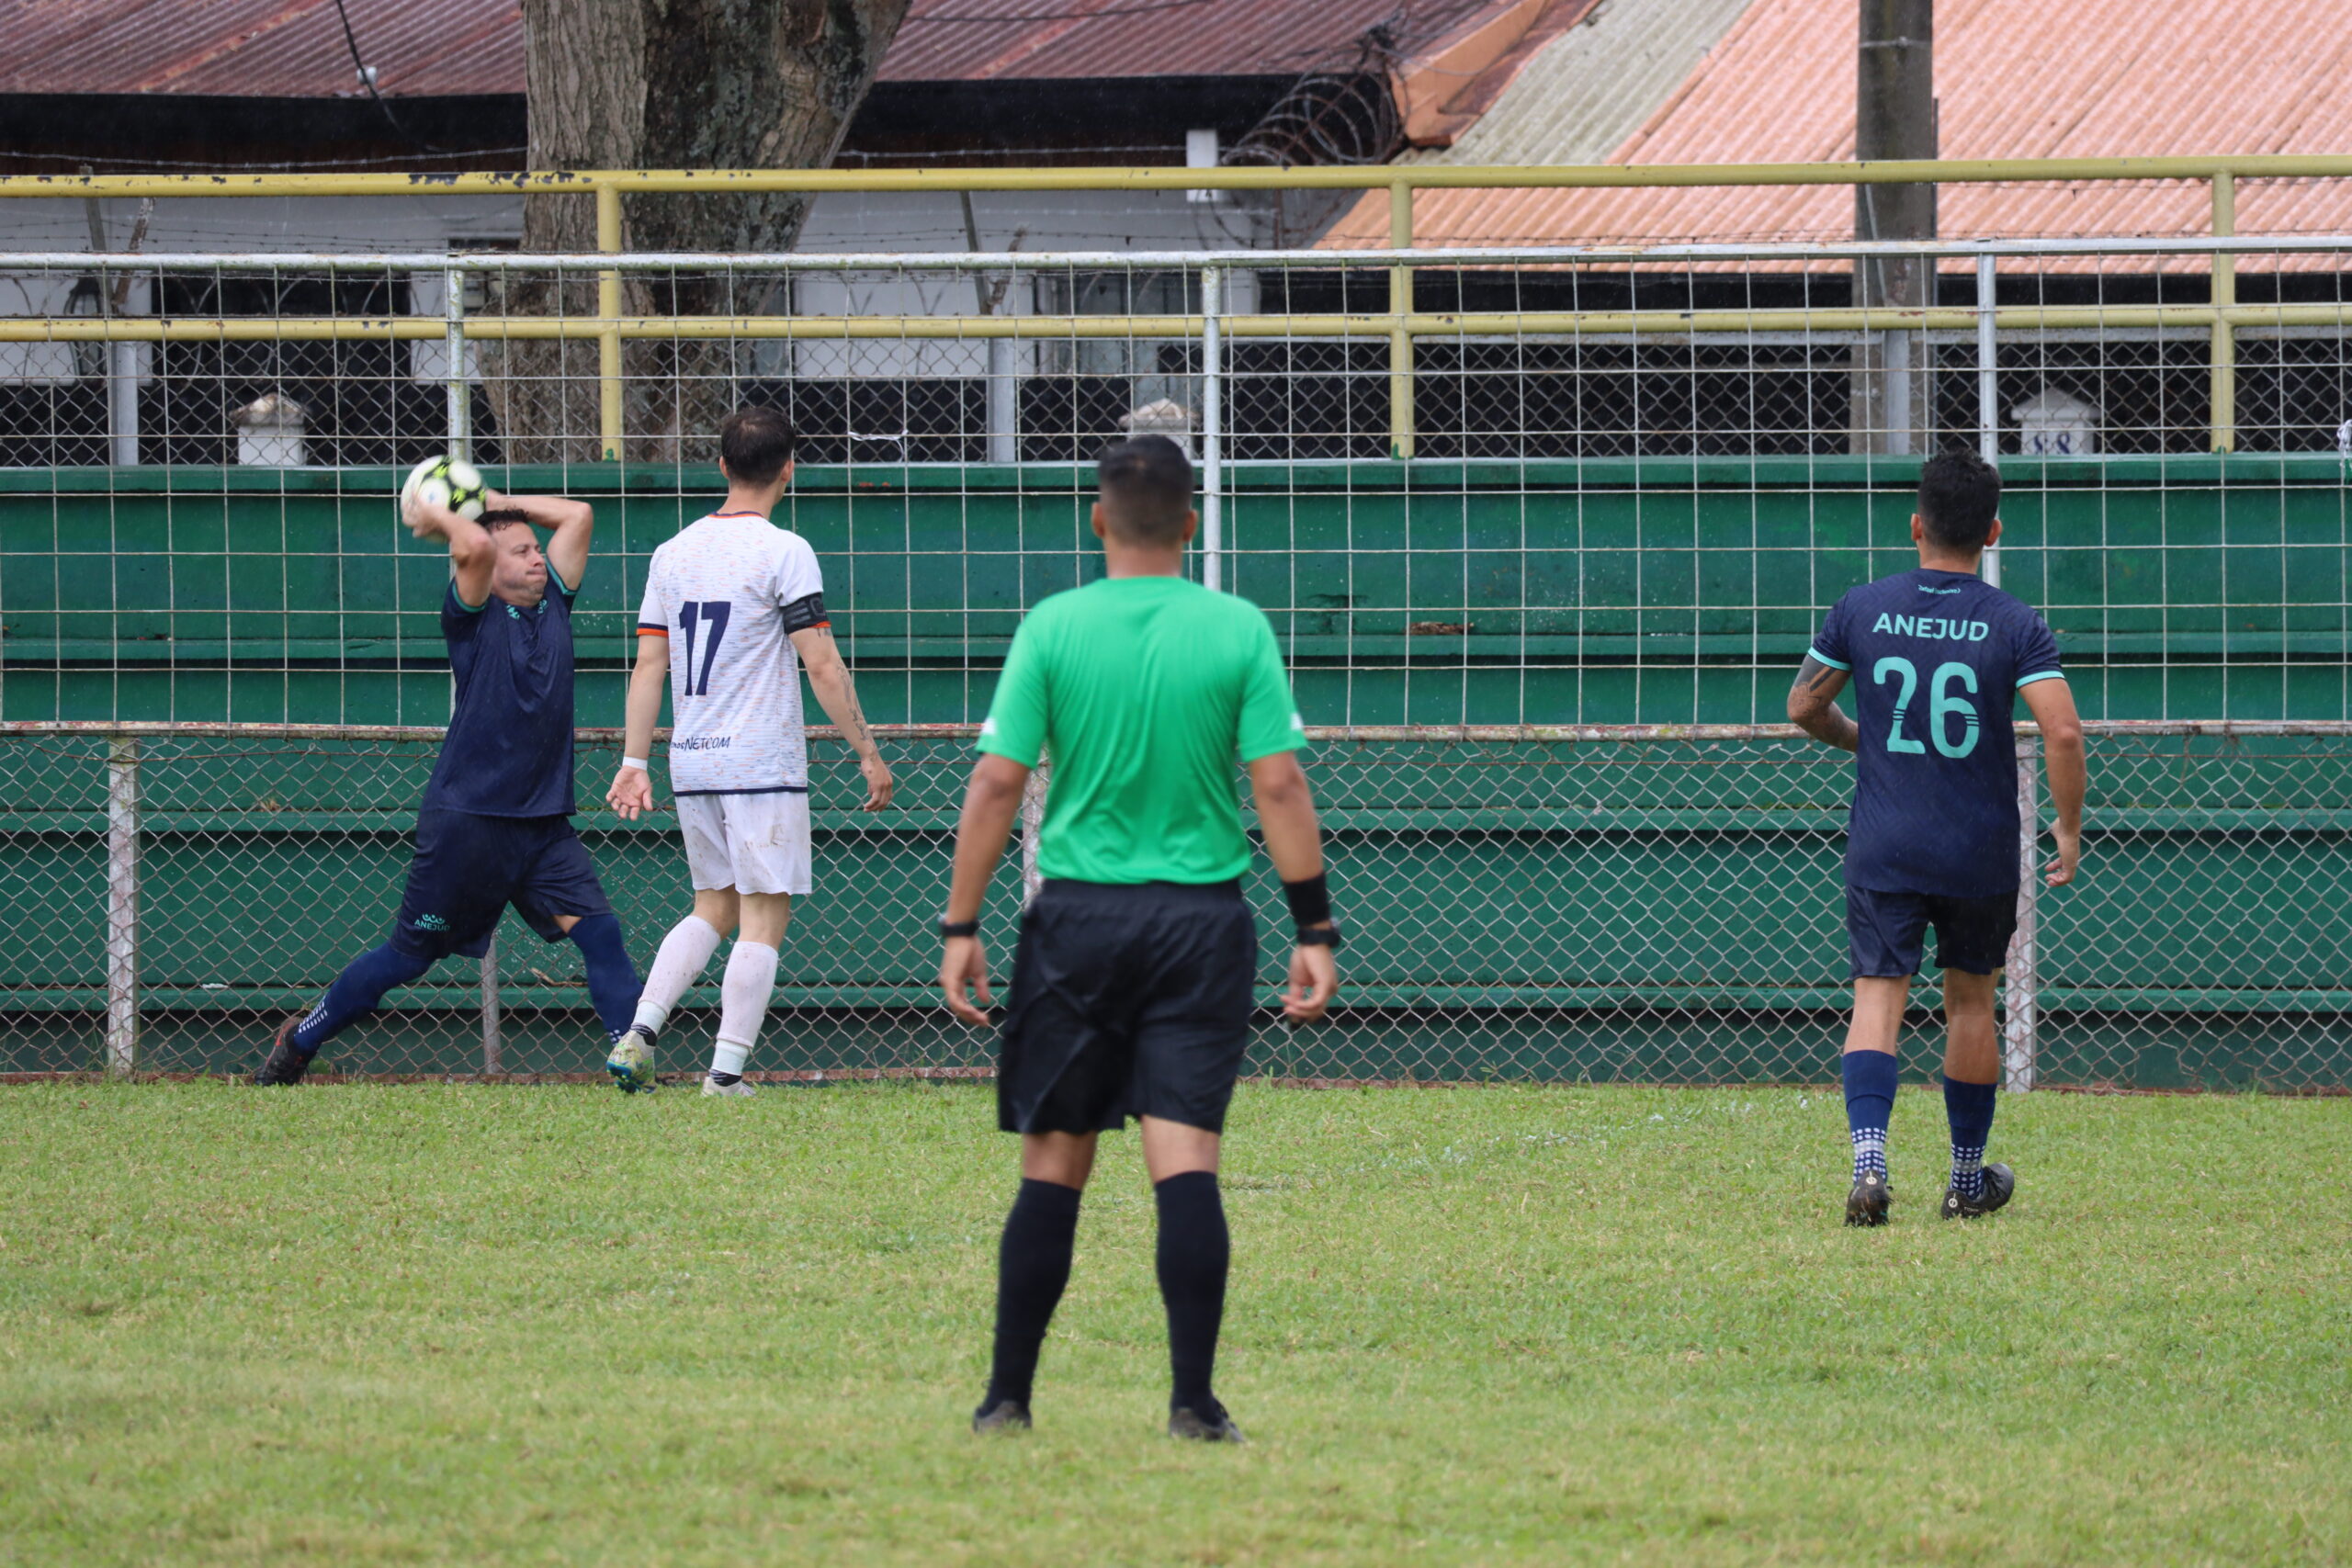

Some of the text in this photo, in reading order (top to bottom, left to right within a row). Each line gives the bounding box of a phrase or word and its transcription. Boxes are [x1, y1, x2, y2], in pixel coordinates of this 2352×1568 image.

[679, 601, 731, 696] 17
[1871, 612, 1989, 641] ANEJUD
[1873, 656, 1980, 759] 26
